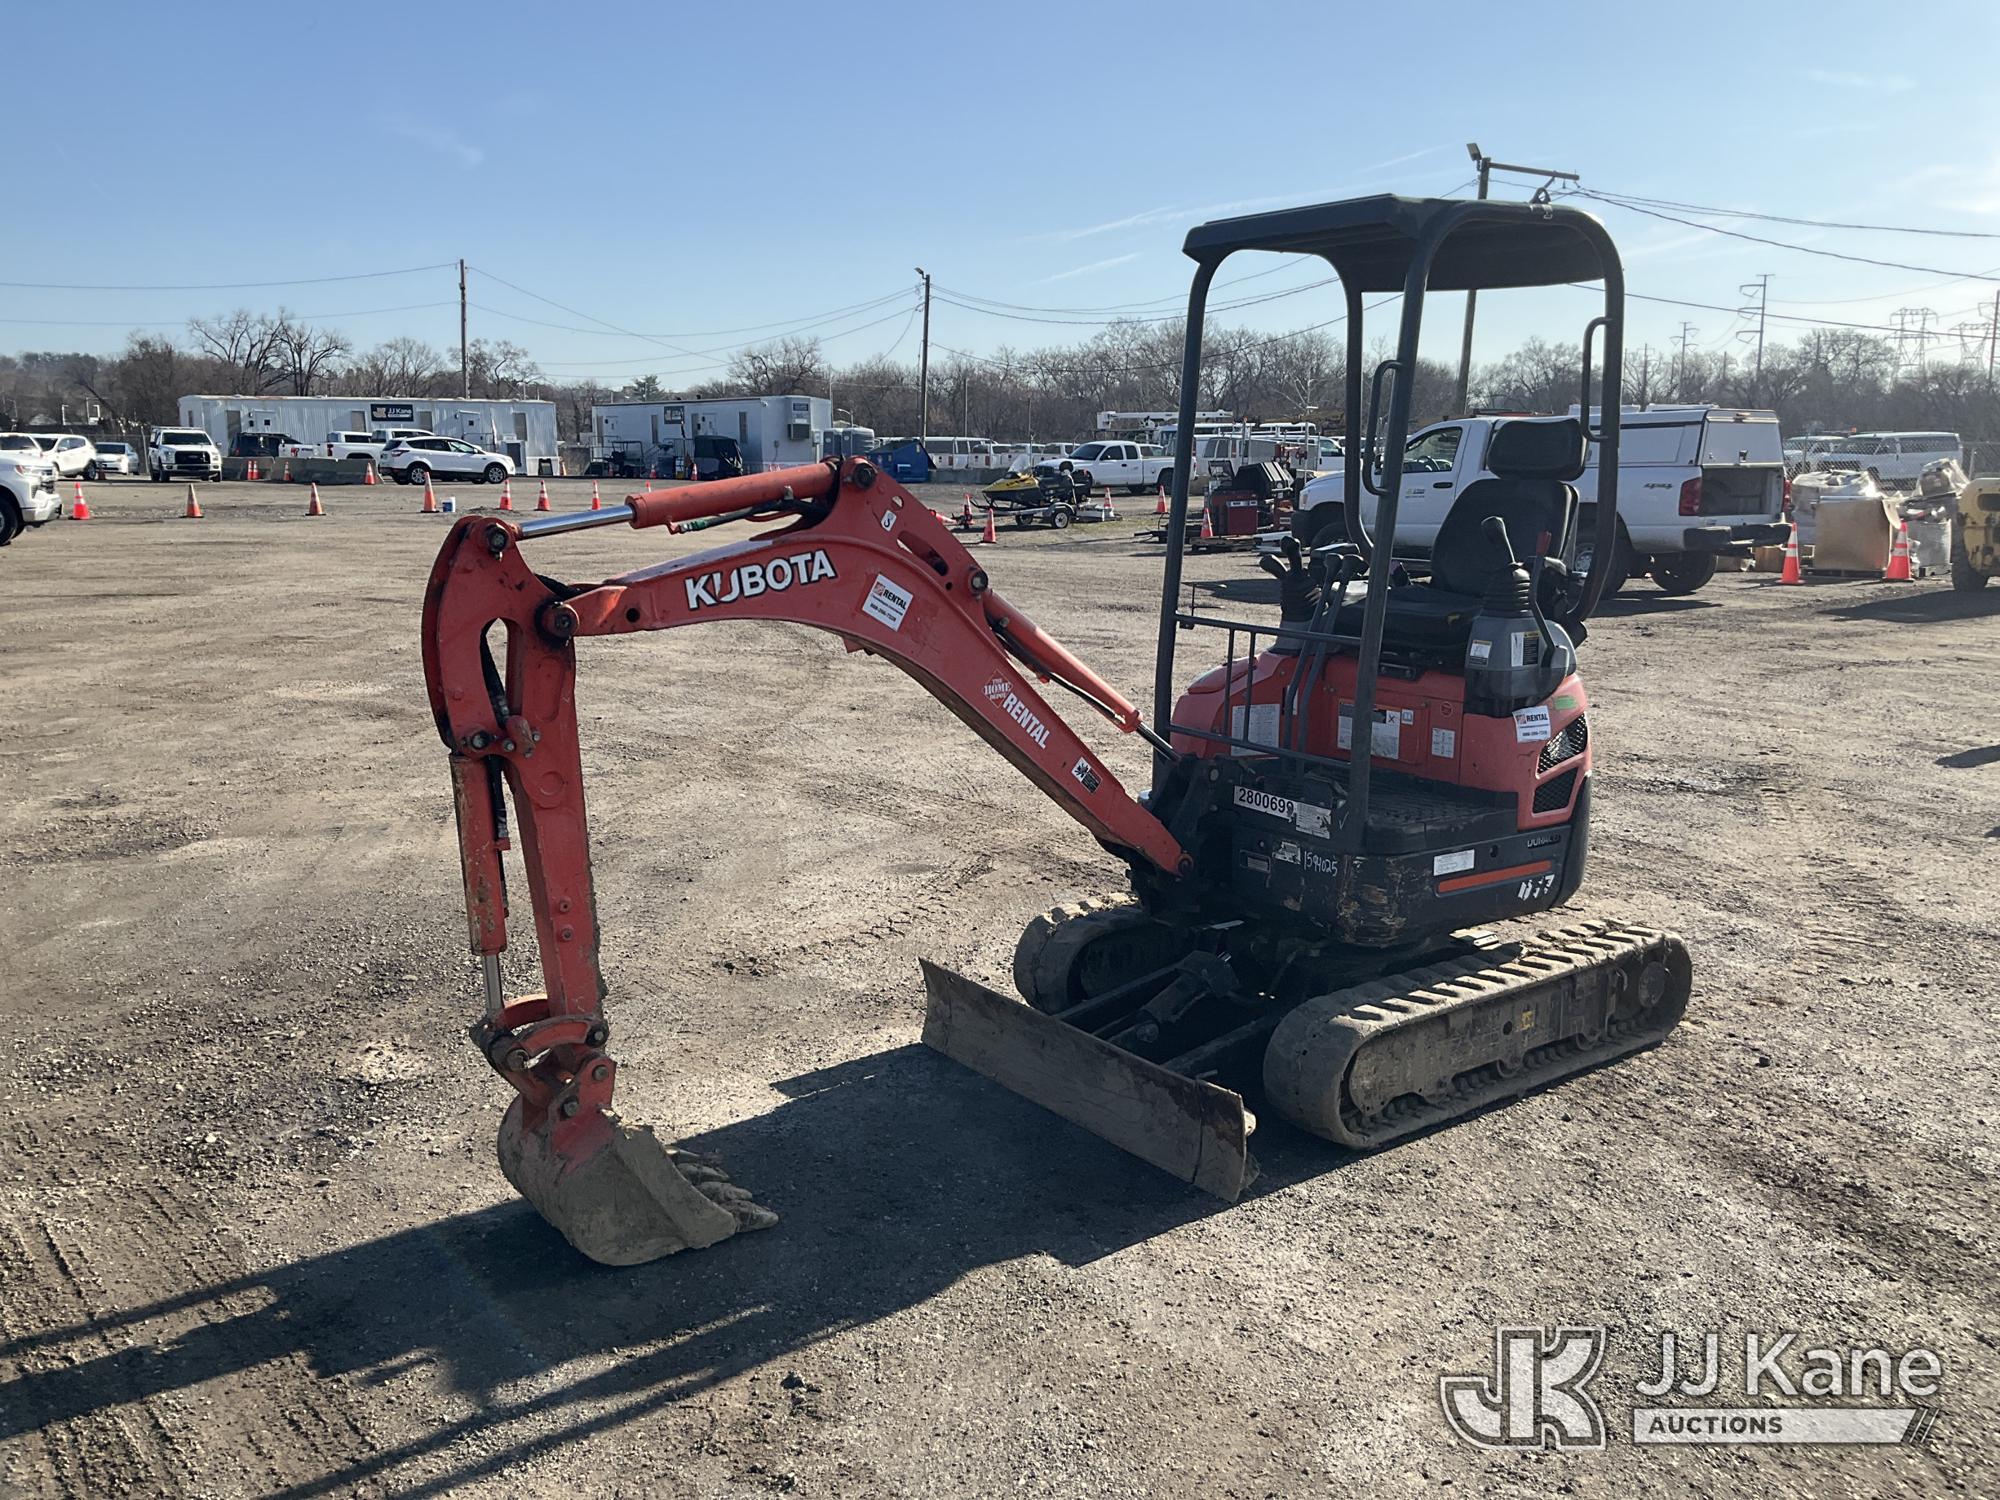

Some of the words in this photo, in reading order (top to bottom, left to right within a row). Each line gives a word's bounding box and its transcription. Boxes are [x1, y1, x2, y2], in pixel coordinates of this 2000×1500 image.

[684, 549, 837, 610] KUBOTA
[882, 589, 907, 610] RENTAL
[983, 682, 1010, 696] HOME
[1002, 692, 1051, 750] RENTAL
[1526, 713, 1548, 721] RENTAL
